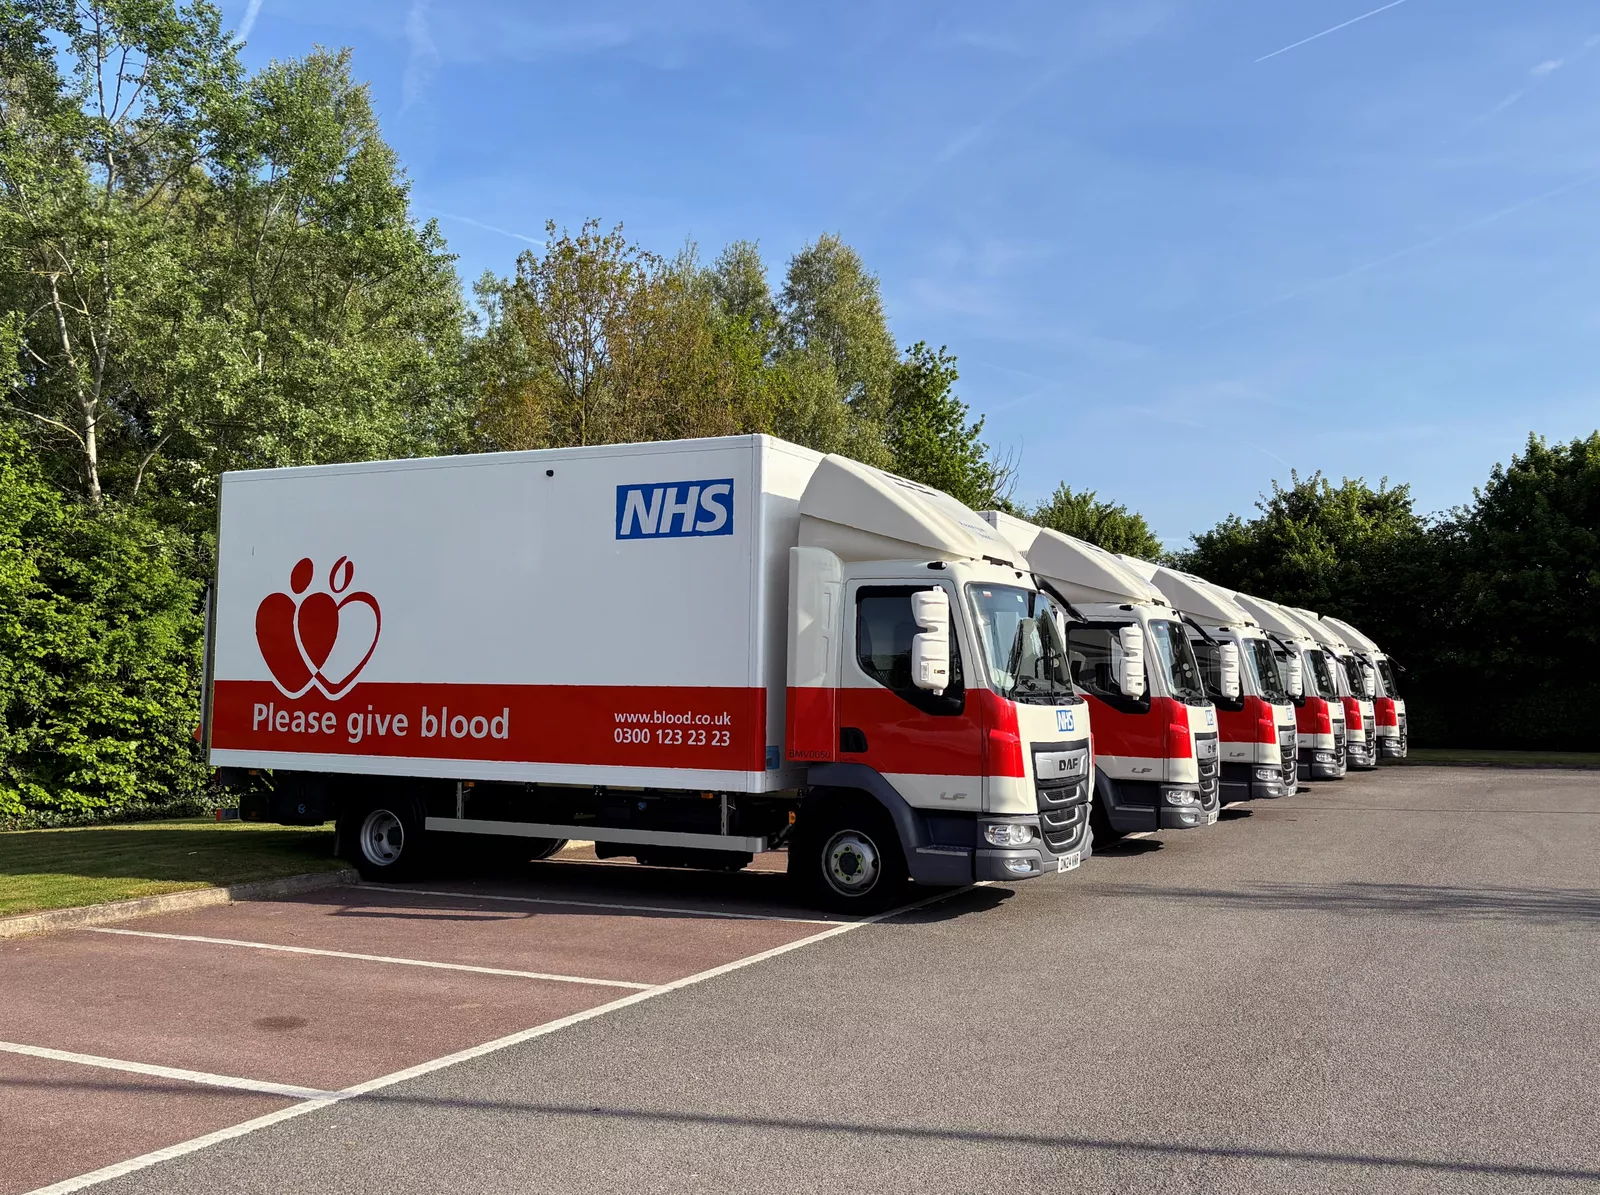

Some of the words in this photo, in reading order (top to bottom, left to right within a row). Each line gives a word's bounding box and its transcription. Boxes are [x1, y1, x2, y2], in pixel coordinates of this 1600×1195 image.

[620, 484, 731, 535] NHS
[253, 702, 337, 735] Please
[346, 704, 409, 744] give
[421, 706, 509, 740] blood
[614, 710, 732, 726] www.blood.co.uk
[1057, 711, 1074, 730] NHS
[614, 728, 651, 744] 0300
[656, 729, 683, 745] 123
[687, 730, 706, 746] 23
[711, 730, 730, 747] 23
[1059, 758, 1078, 771] DAF
[940, 791, 968, 801] LF
